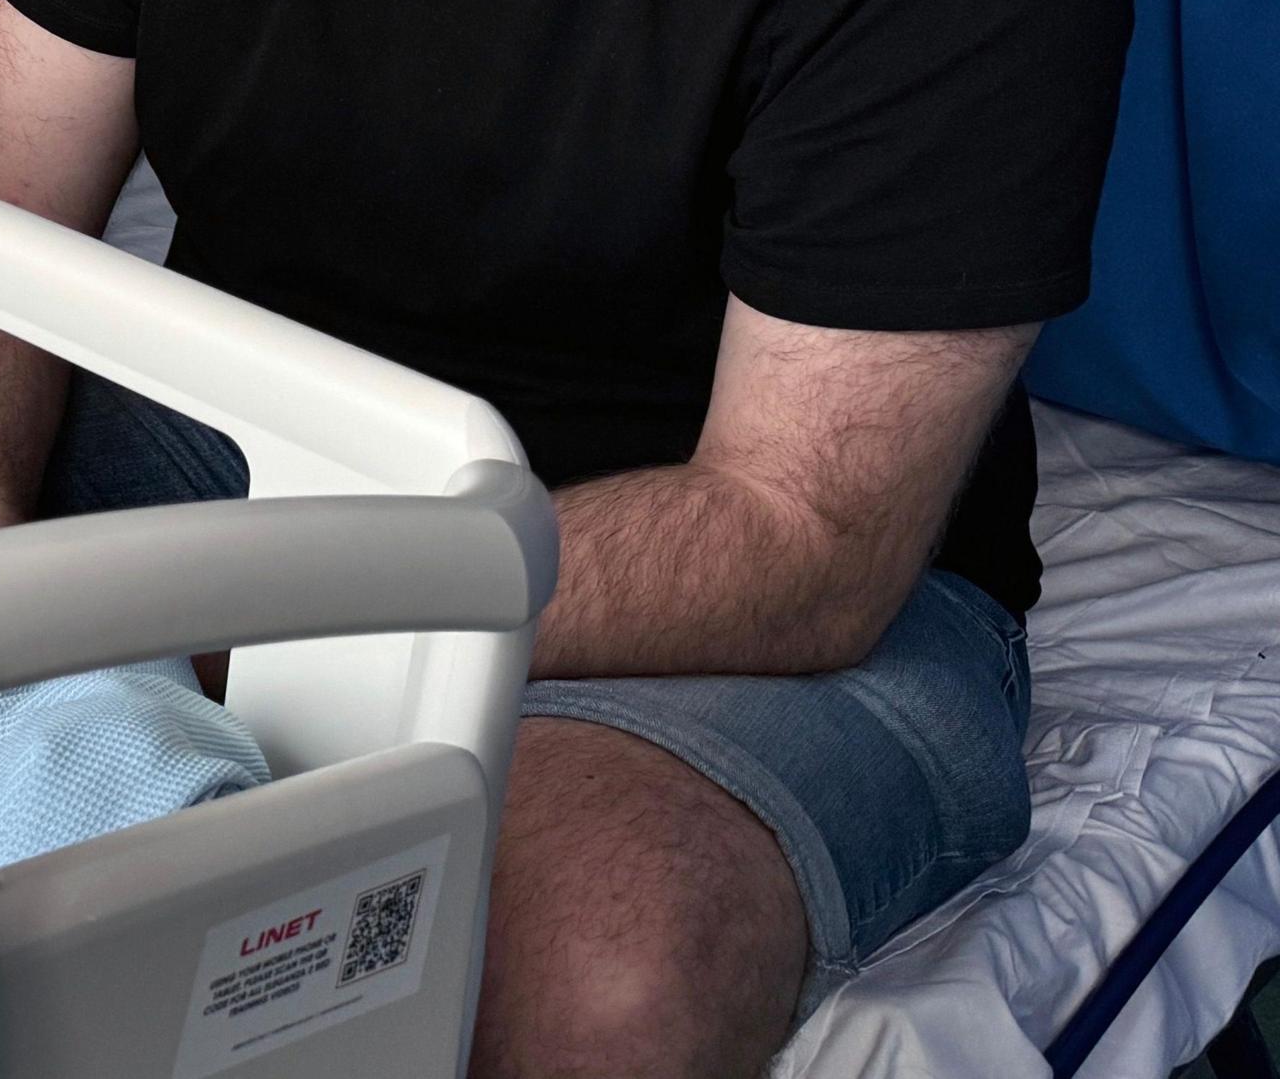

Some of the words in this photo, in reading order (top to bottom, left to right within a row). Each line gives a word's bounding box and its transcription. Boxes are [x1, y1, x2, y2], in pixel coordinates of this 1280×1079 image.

[240, 909, 322, 956] LINET
[274, 961, 298, 977] SCAN
[229, 991, 246, 1006] FOR
